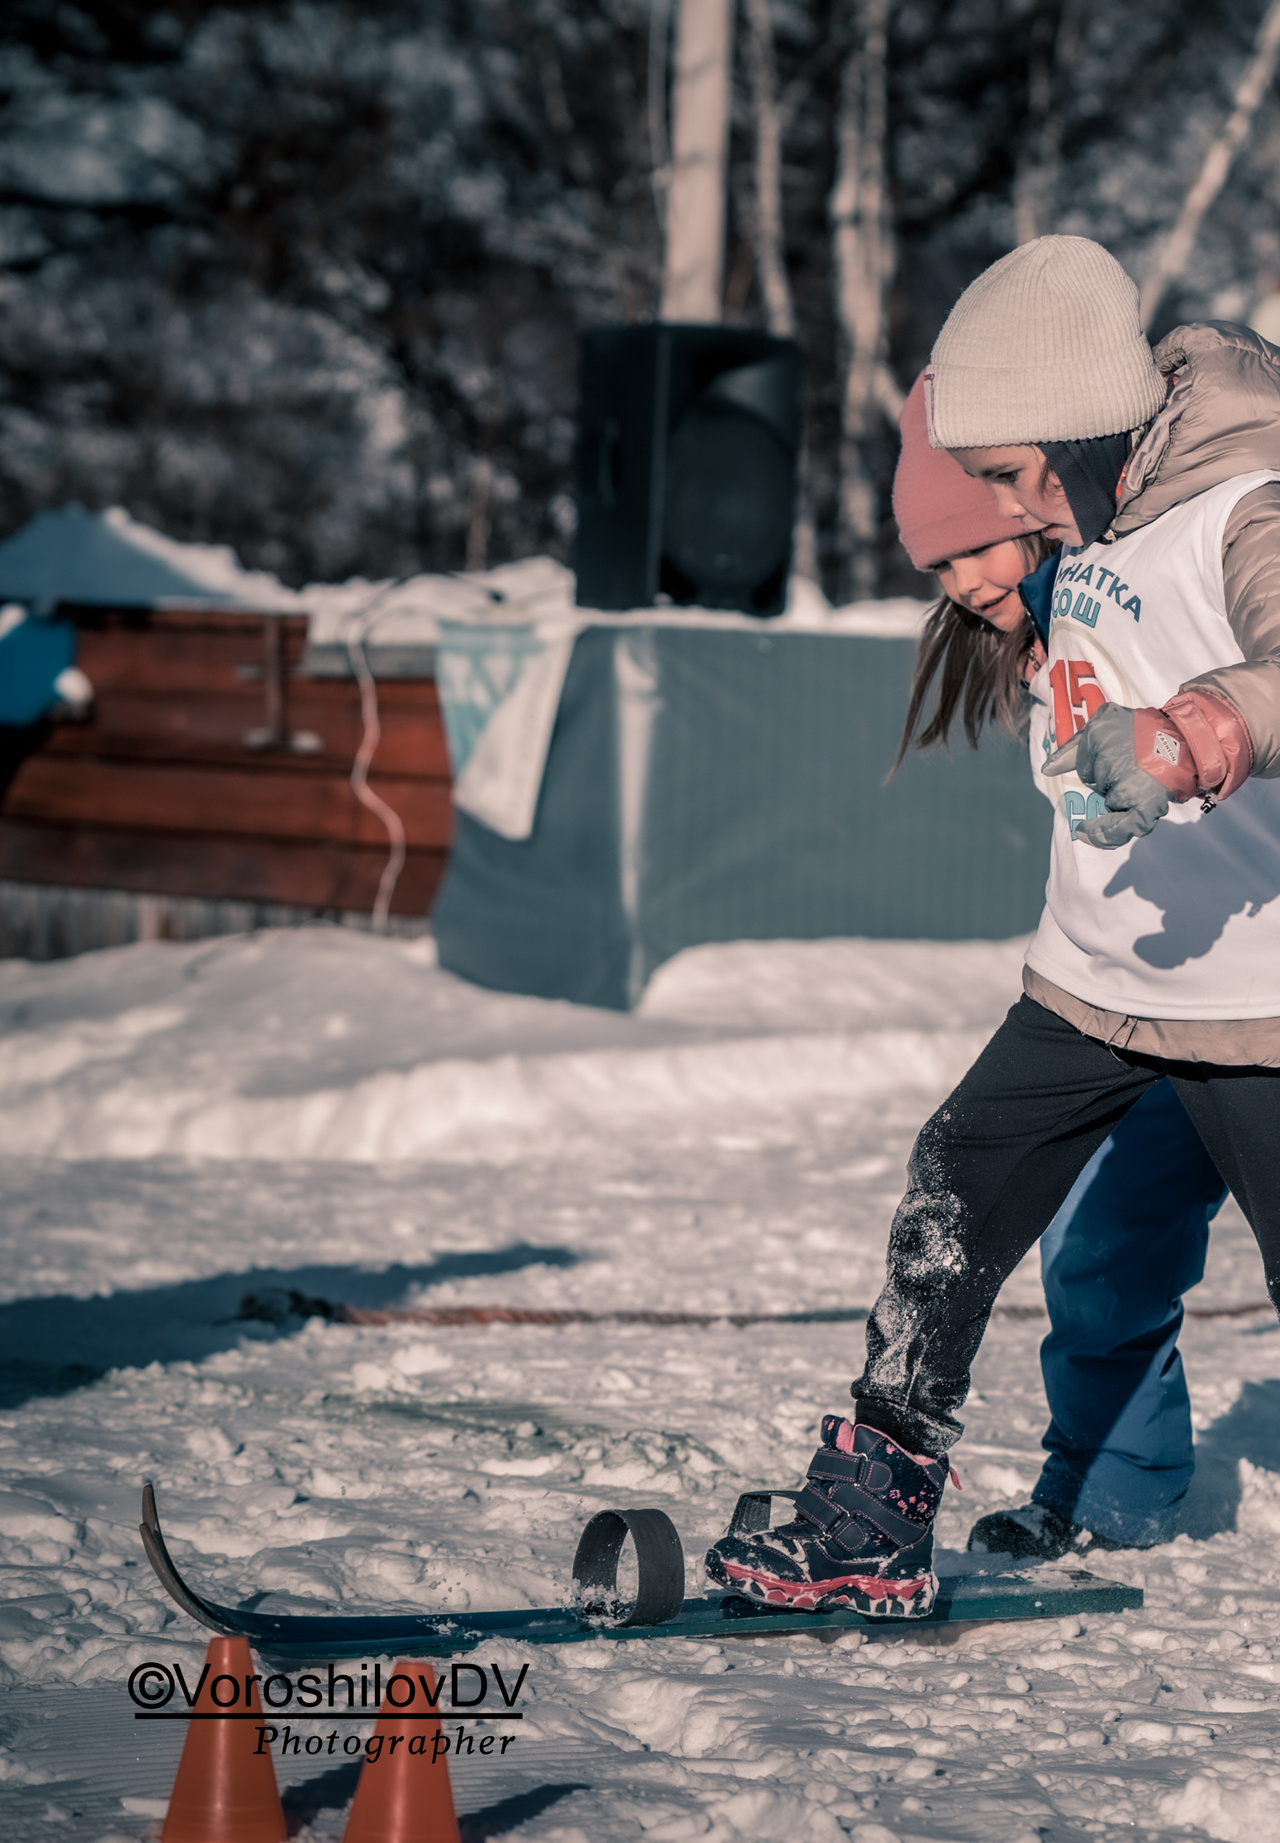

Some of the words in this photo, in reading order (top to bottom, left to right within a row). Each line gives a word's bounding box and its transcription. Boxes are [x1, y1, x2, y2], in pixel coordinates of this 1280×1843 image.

[1052, 588, 1102, 629] СОШ
[1055, 562, 1141, 623] МЧАТКА
[1049, 659, 1107, 750] 15
[1157, 732, 1177, 762] FASHION
